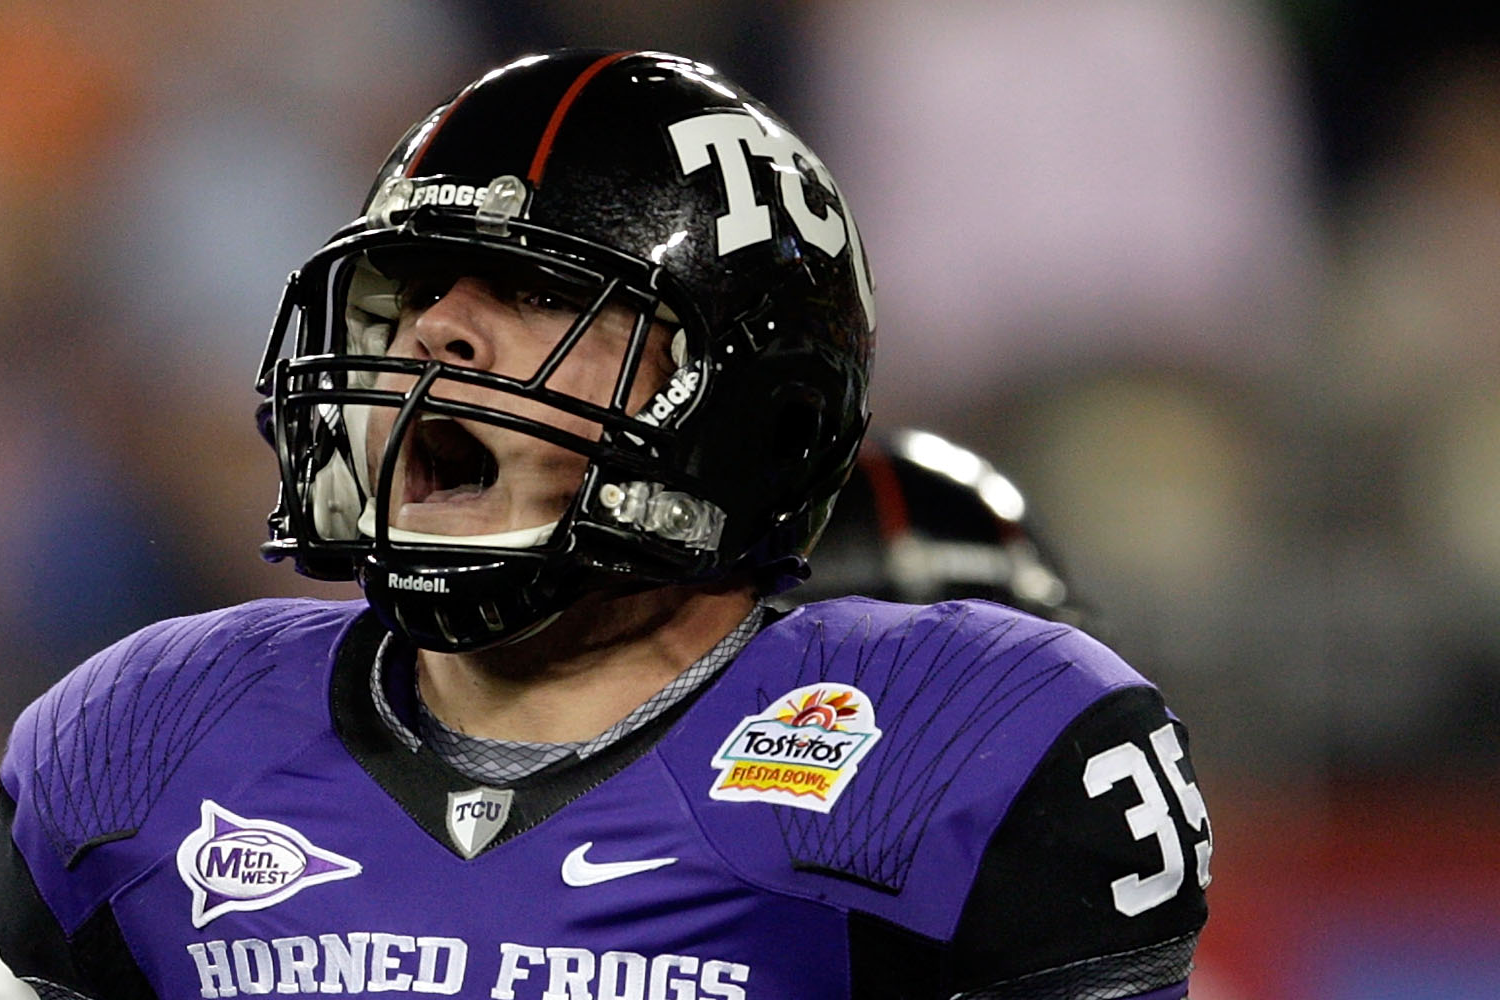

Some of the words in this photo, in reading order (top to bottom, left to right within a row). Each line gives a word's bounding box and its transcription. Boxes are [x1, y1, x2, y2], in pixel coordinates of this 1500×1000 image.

[731, 765, 779, 782] FIESTA
[781, 770, 831, 791] BOWL
[455, 801, 502, 822] TCU
[205, 846, 280, 879] Mtn.
[240, 871, 289, 885] WEST
[186, 932, 468, 999] HORNED
